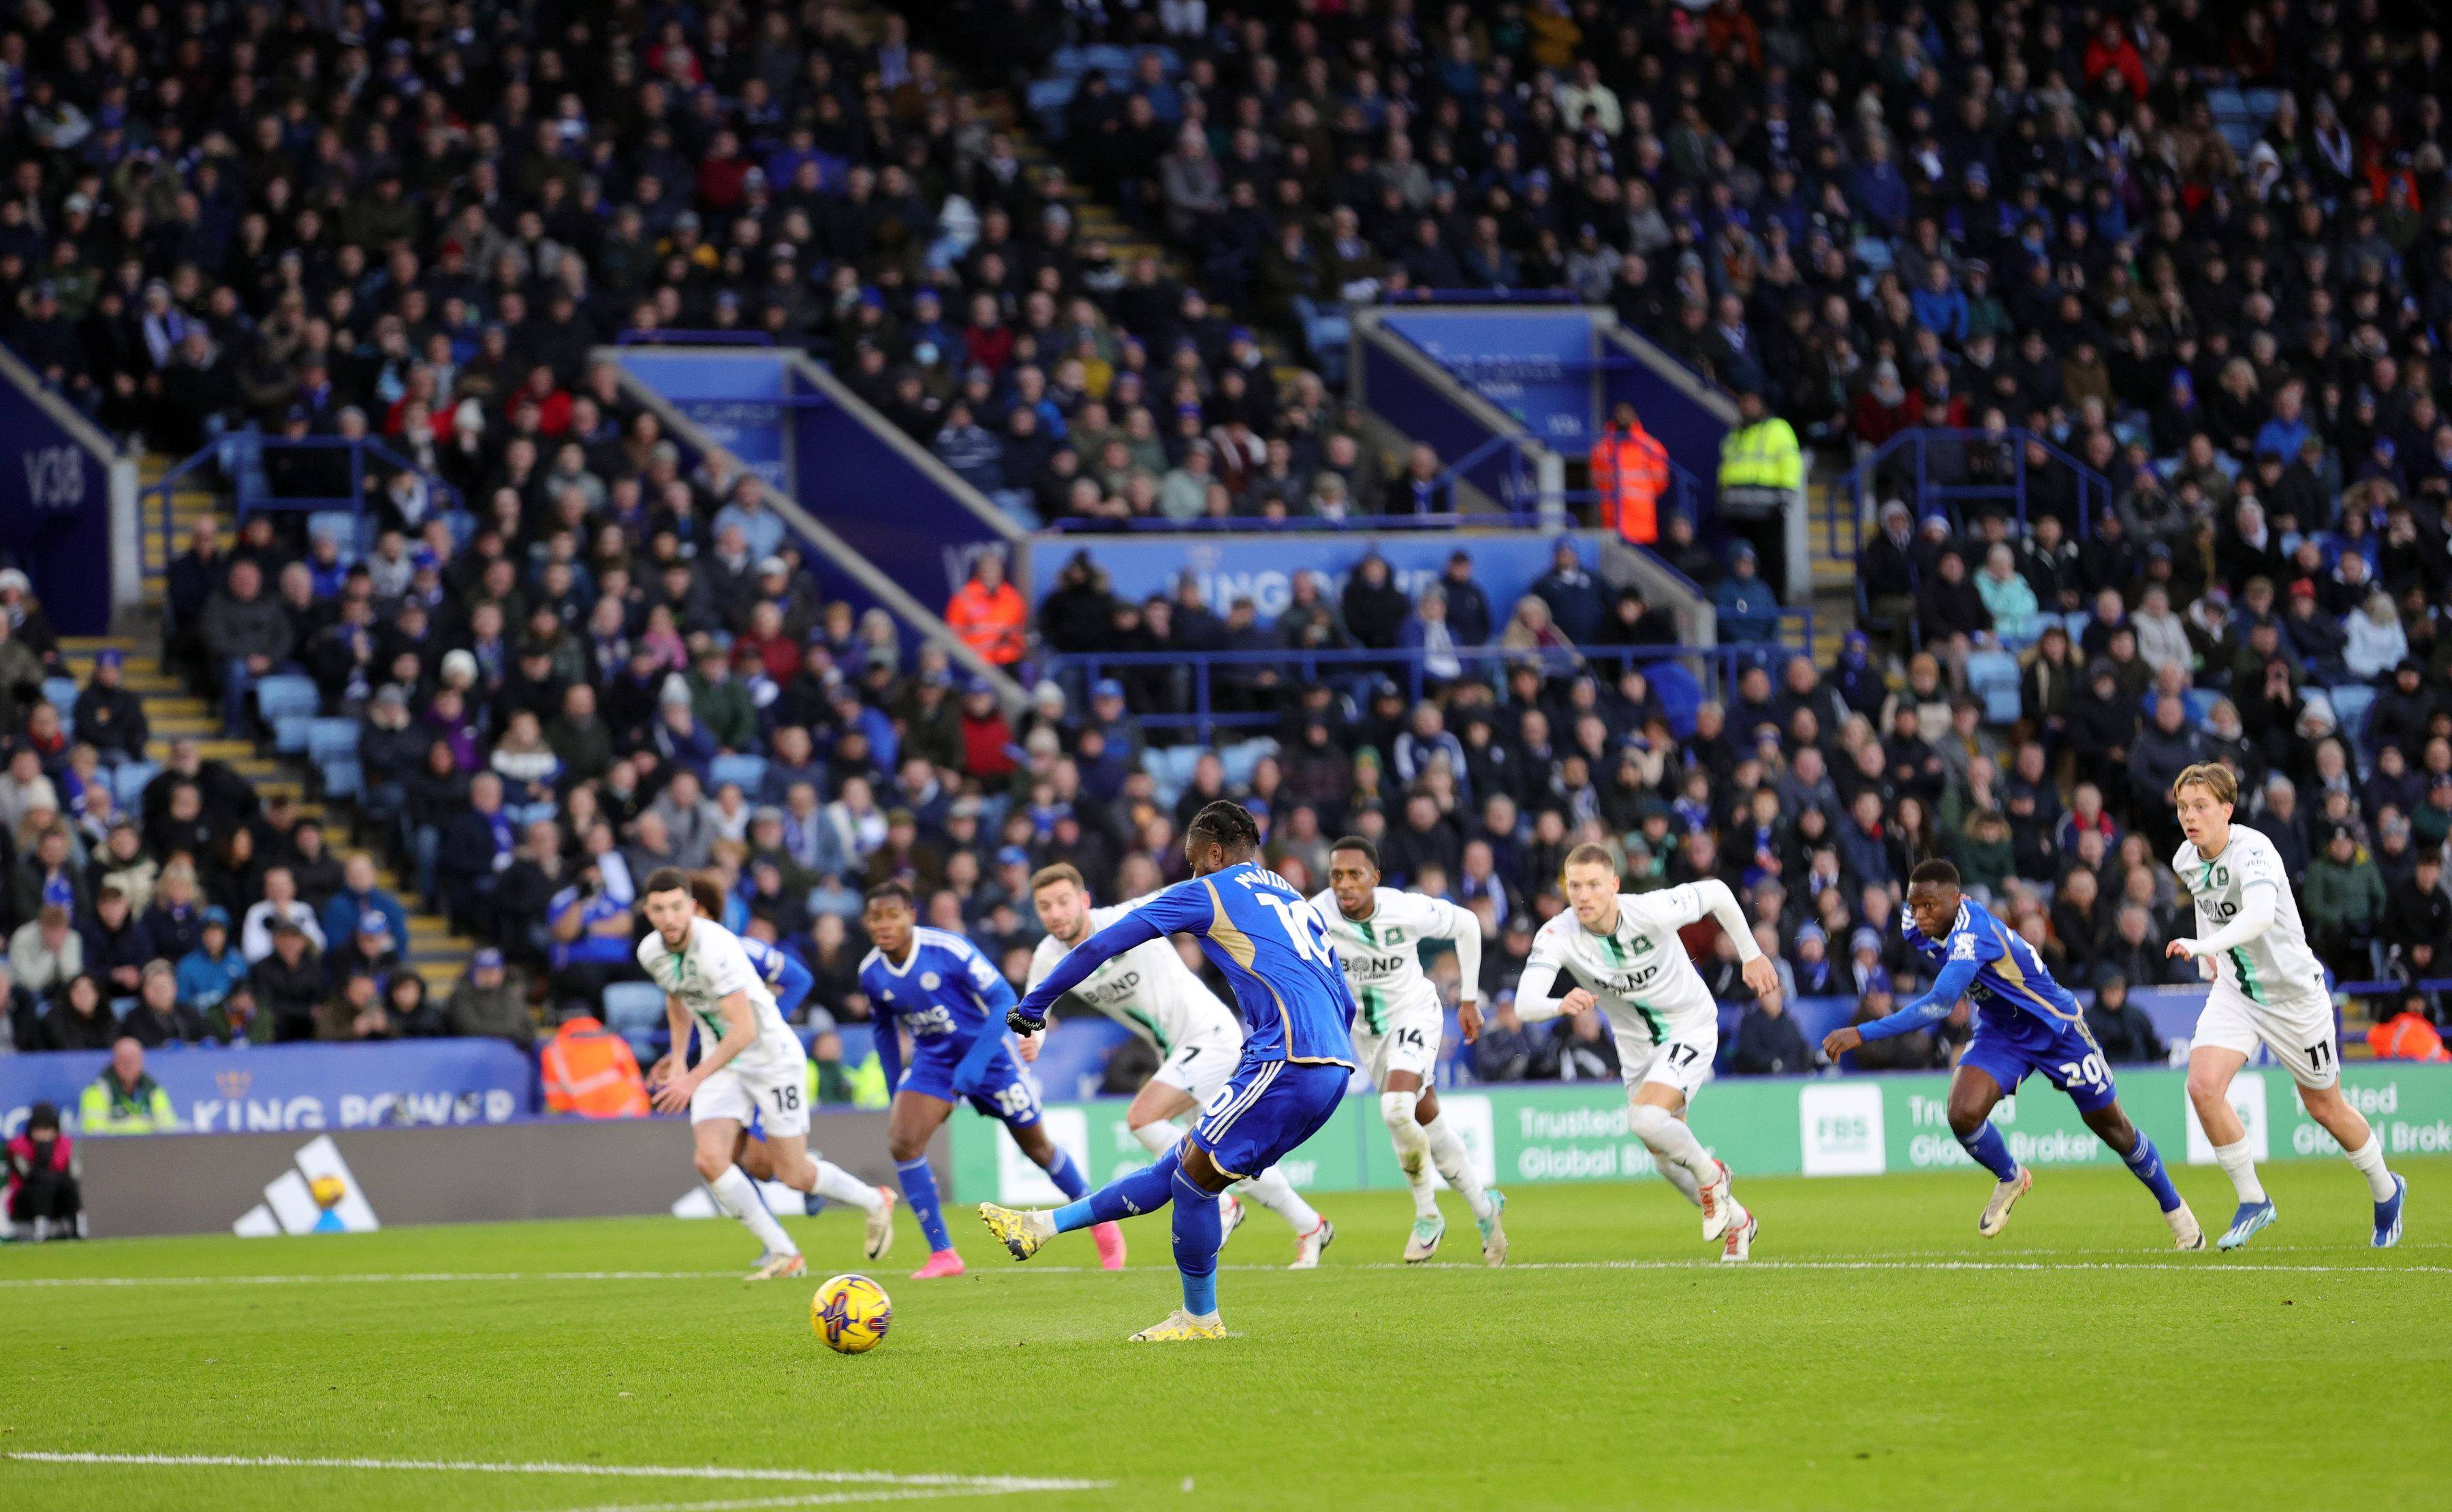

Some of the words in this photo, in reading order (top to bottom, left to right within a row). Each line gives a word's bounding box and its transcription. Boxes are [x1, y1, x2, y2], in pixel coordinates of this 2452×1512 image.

[1255, 892, 1335, 968] 10
[1084, 970, 1140, 1004] BOND
[1179, 1045, 1201, 1065] 7
[1398, 1026, 1424, 1052] 14
[1668, 1042, 1699, 1068] 17
[2304, 1040, 2331, 1071] 11
[2058, 1052, 2103, 1088] 20
[193, 1095, 326, 1133] KING
[771, 1085, 800, 1113] 18
[993, 1082, 1032, 1117] 18
[1518, 1144, 1617, 1179] Global
[2010, 1130, 2097, 1163] Broker
